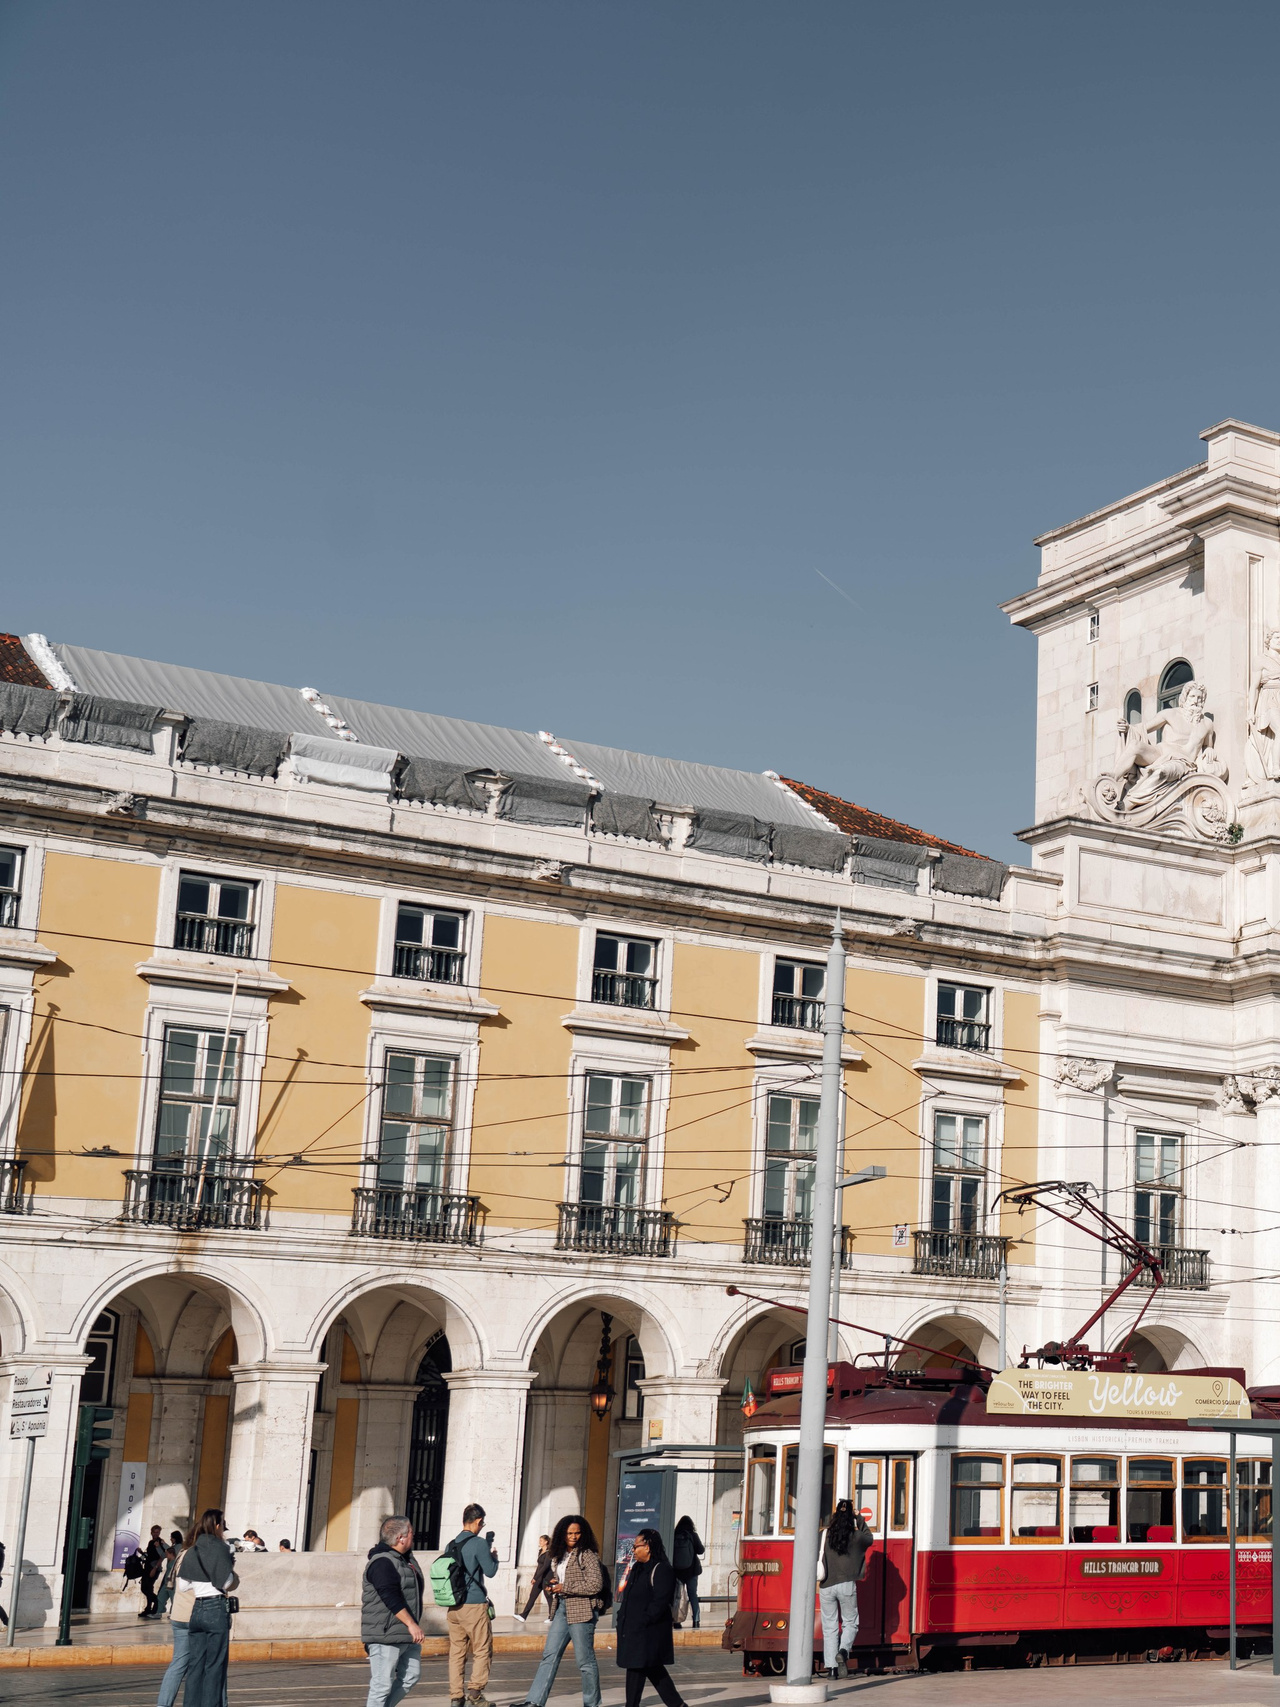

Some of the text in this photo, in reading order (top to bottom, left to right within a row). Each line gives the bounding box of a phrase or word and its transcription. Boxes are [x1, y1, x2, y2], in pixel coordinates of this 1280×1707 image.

[14, 1375, 28, 1386] Rossio
[1018, 1380, 1074, 1391] THE BRIGHTER
[1021, 1390, 1071, 1401] WAY TO FEEL
[12, 1397, 42, 1410] Restauradores
[1028, 1401, 1064, 1411] THE CITY.
[764, 1562, 780, 1572] TOUR
[1084, 1561, 1107, 1574] HILLS
[1140, 1561, 1159, 1573] TOUR
